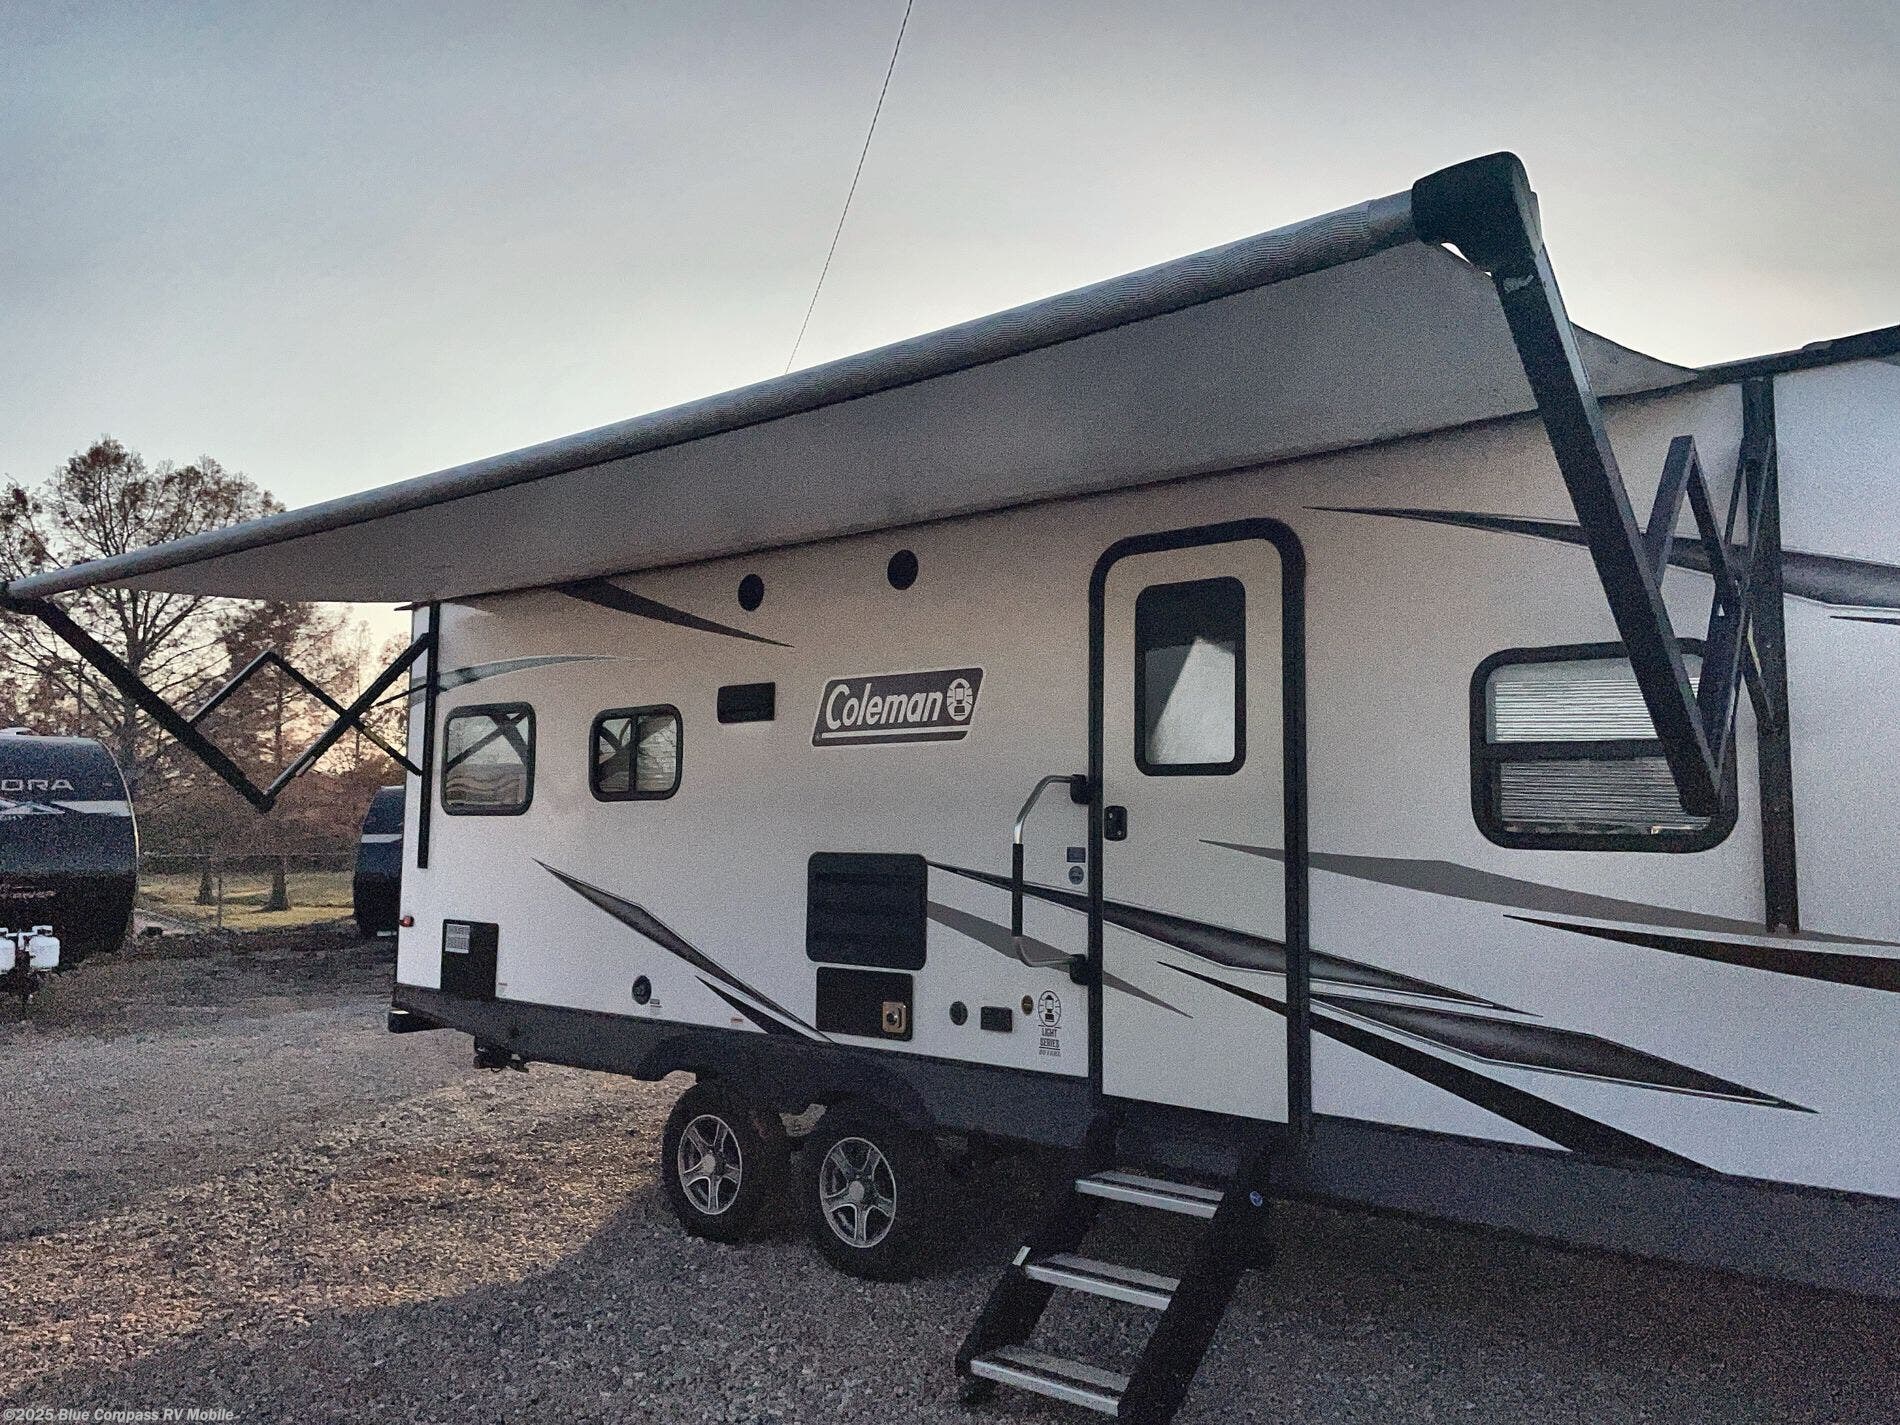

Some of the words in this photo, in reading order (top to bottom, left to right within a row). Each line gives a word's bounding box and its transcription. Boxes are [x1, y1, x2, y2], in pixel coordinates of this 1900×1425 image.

[825, 682, 943, 730] Coleman
[1, 779, 75, 791] ORA
[1041, 1027, 1058, 1038] LIGHT
[1040, 1038, 1060, 1048] SERIES
